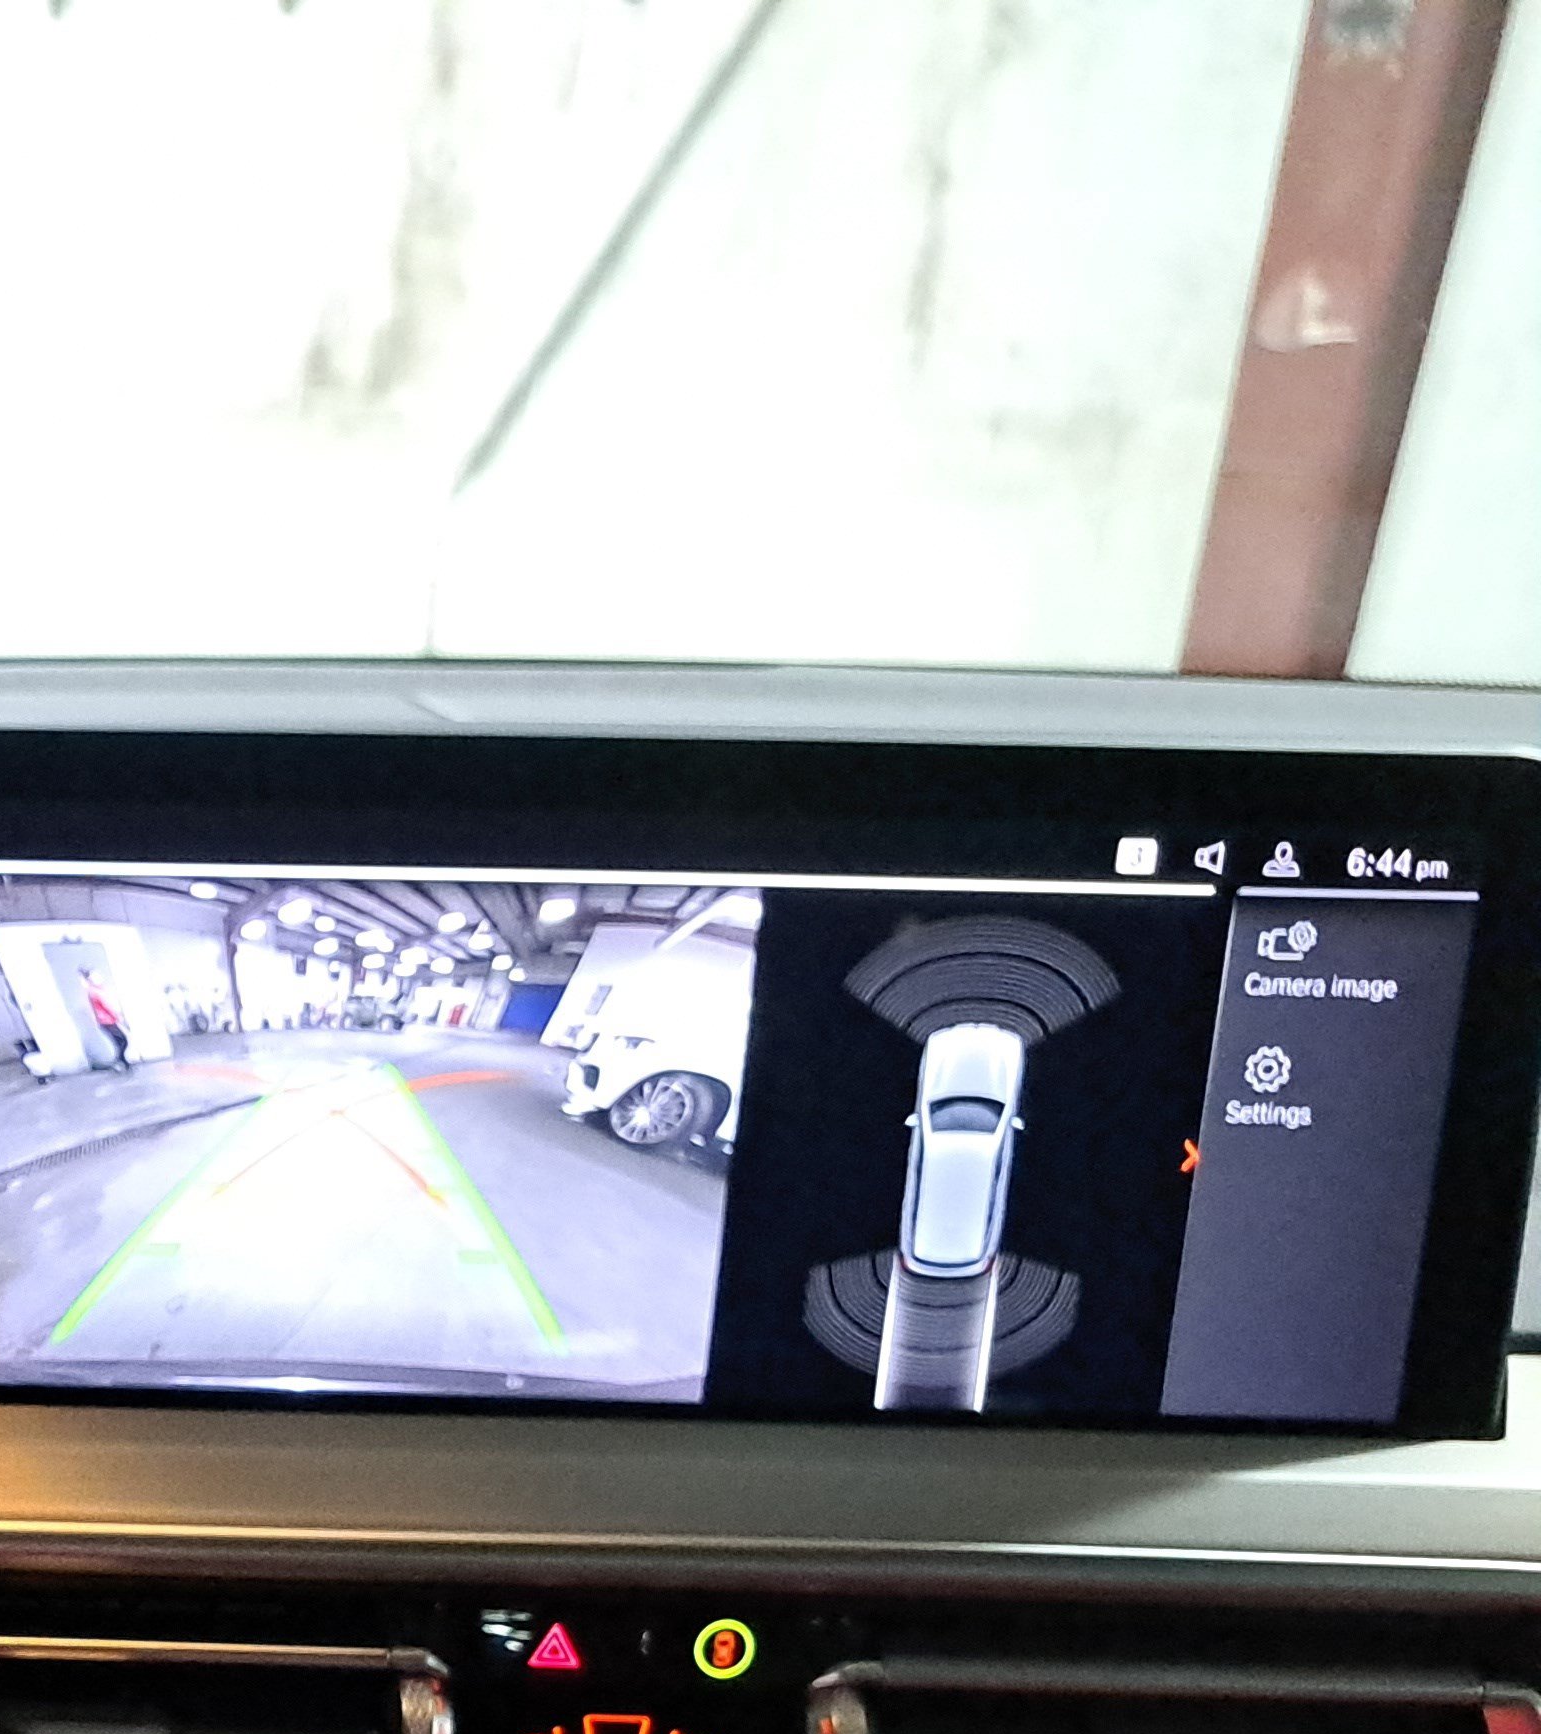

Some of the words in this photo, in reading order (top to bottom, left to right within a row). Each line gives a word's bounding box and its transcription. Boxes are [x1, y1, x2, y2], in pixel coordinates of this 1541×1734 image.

[1346, 846, 1411, 880] 6:44
[1415, 856, 1449, 881] pm
[1244, 971, 1325, 999] Camera
[1225, 1099, 1312, 1130] Settings
